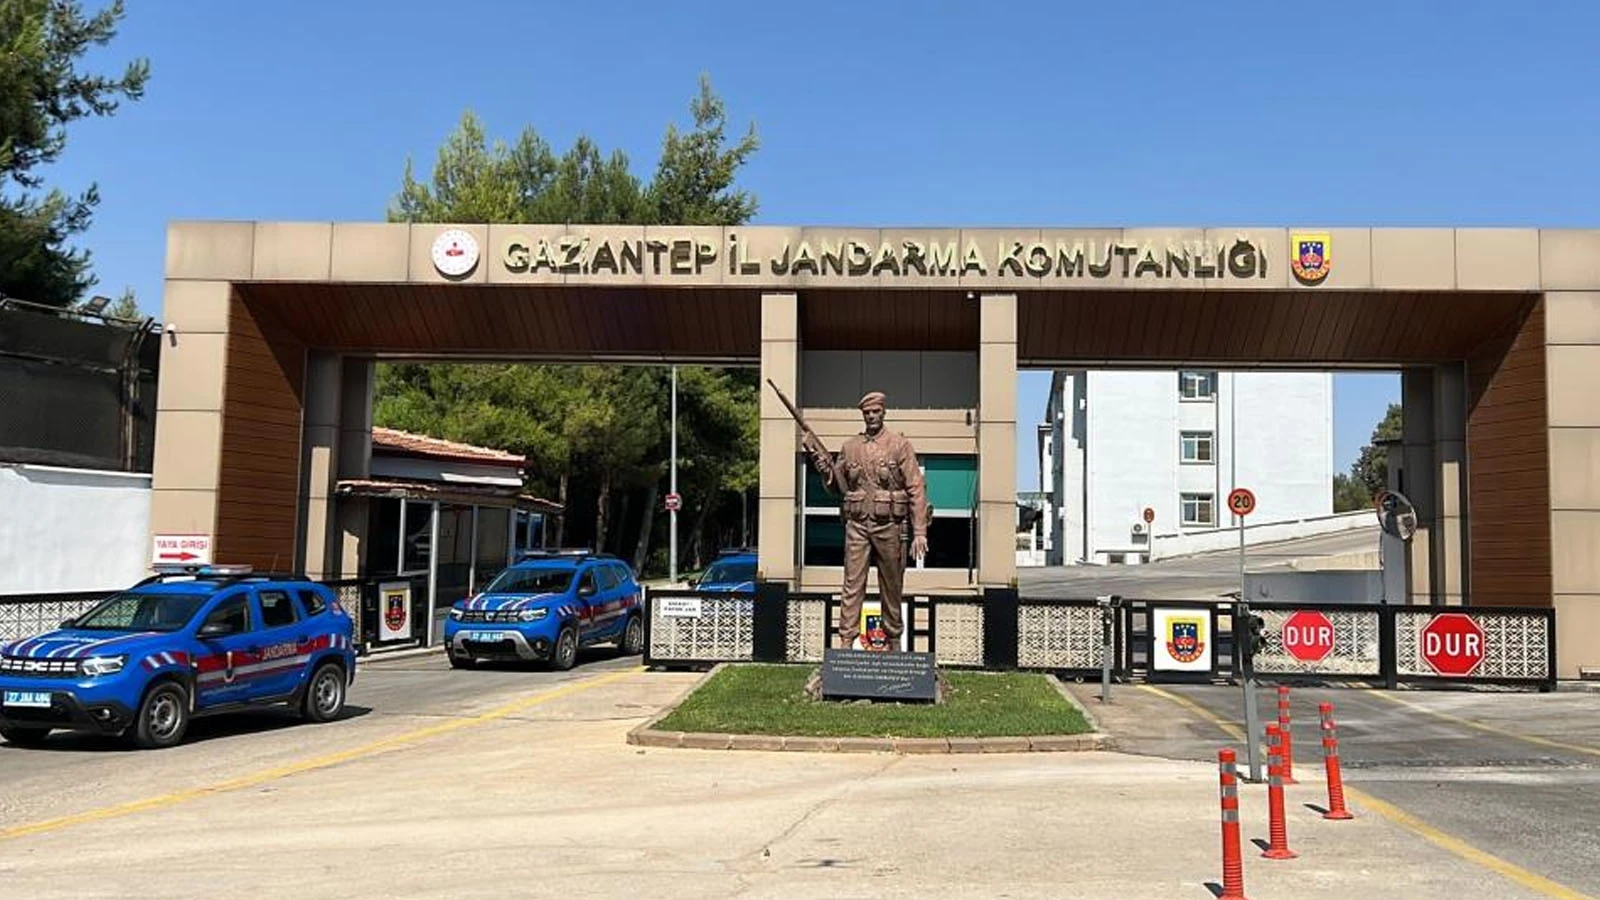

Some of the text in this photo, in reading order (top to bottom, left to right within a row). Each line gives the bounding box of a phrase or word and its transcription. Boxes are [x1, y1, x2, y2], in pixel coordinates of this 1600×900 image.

[503, 233, 717, 275] GAZİANTEP
[728, 233, 760, 275] İL
[771, 236, 986, 277] JANDARMA
[998, 234, 1268, 278] KOMUTANLIĞI
[1234, 495, 1250, 508] 20
[157, 540, 178, 549] YAYA
[1286, 626, 1331, 646] DUR
[1426, 633, 1480, 657] DUR
